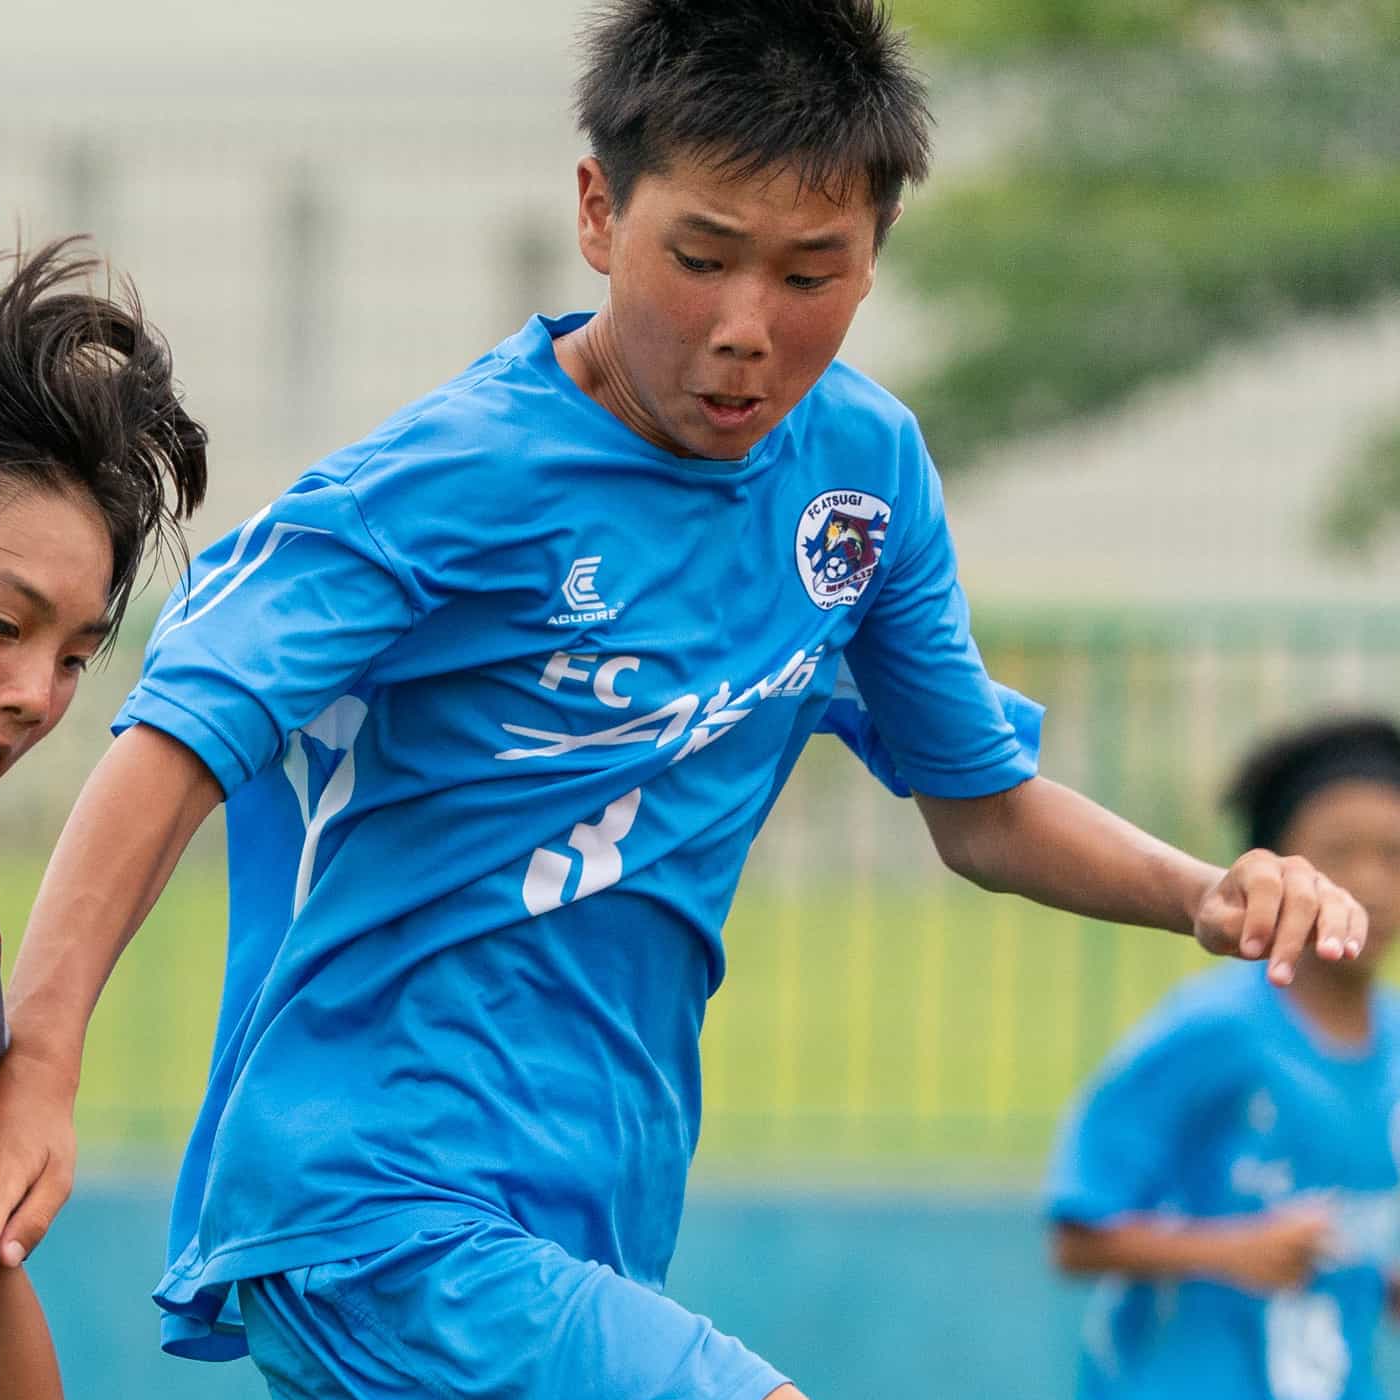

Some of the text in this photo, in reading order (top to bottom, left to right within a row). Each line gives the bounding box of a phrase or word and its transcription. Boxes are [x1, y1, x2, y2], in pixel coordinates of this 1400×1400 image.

[822, 494, 863, 507] ATSUGI
[547, 608, 618, 625] ACUORE
[538, 651, 641, 709] FC
